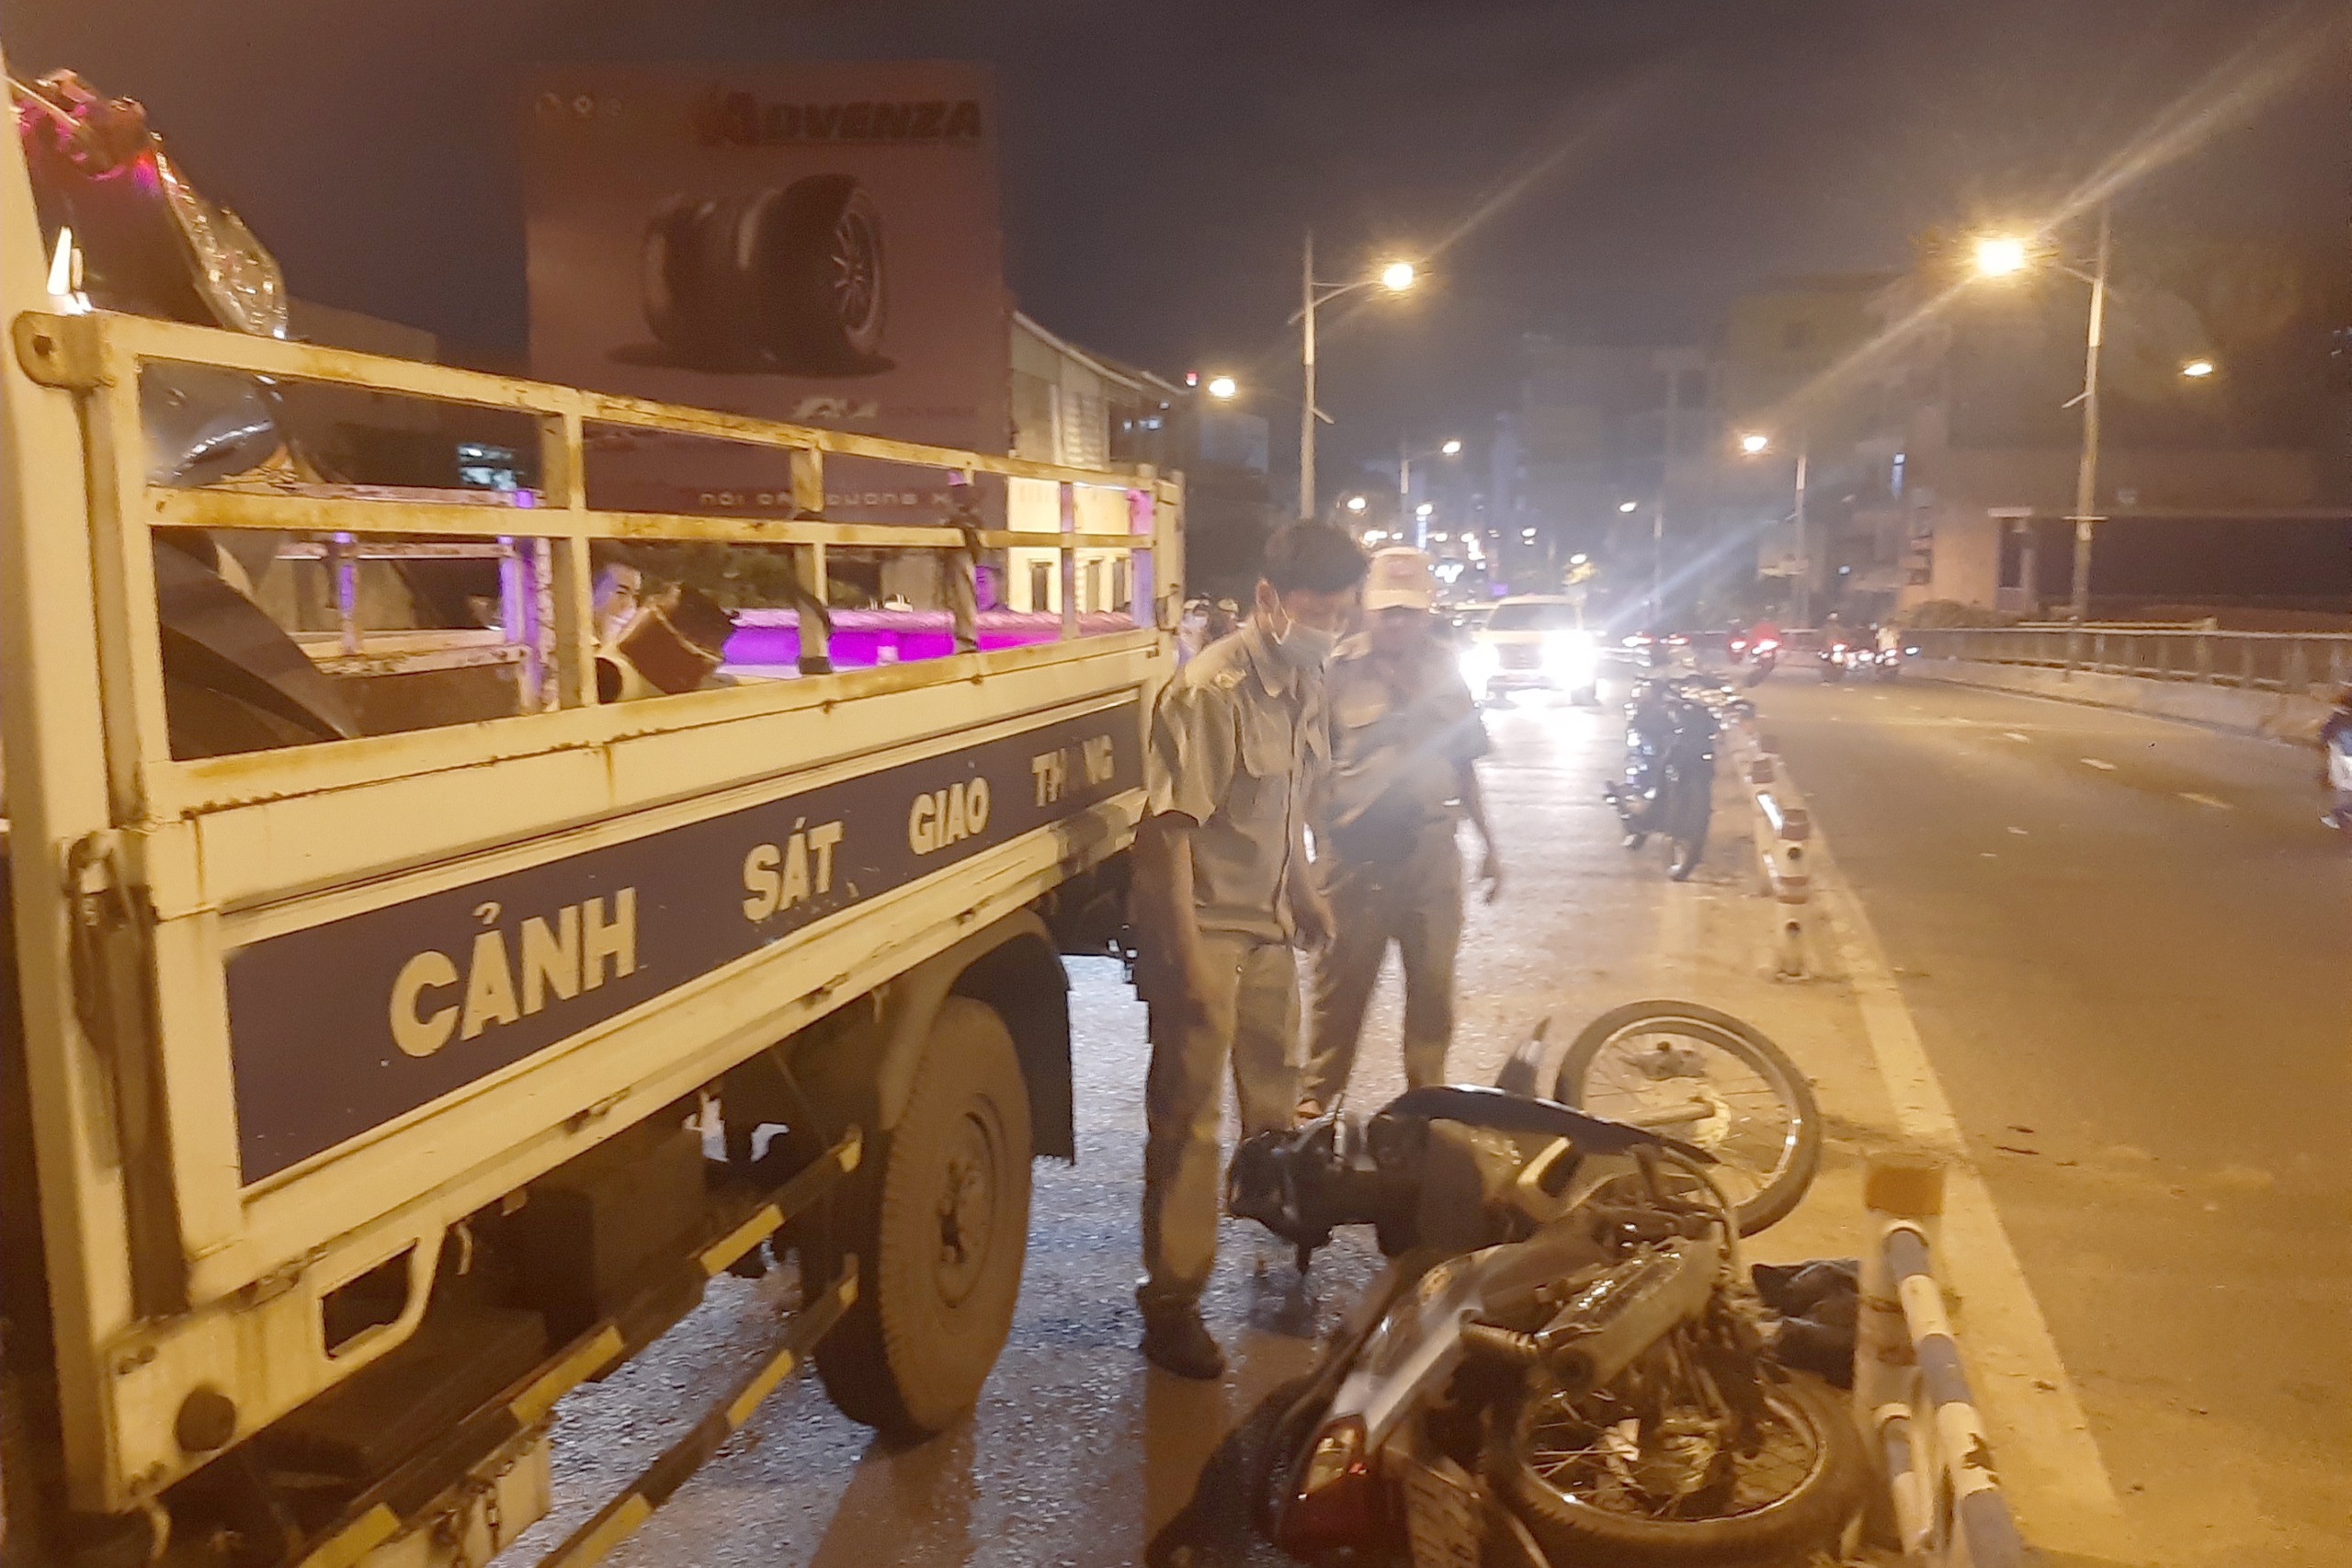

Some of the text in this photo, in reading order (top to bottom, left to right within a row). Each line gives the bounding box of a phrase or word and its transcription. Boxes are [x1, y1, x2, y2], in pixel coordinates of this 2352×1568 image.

[390, 734, 1116, 1057] CẢNH SÁT GIAO THNG
